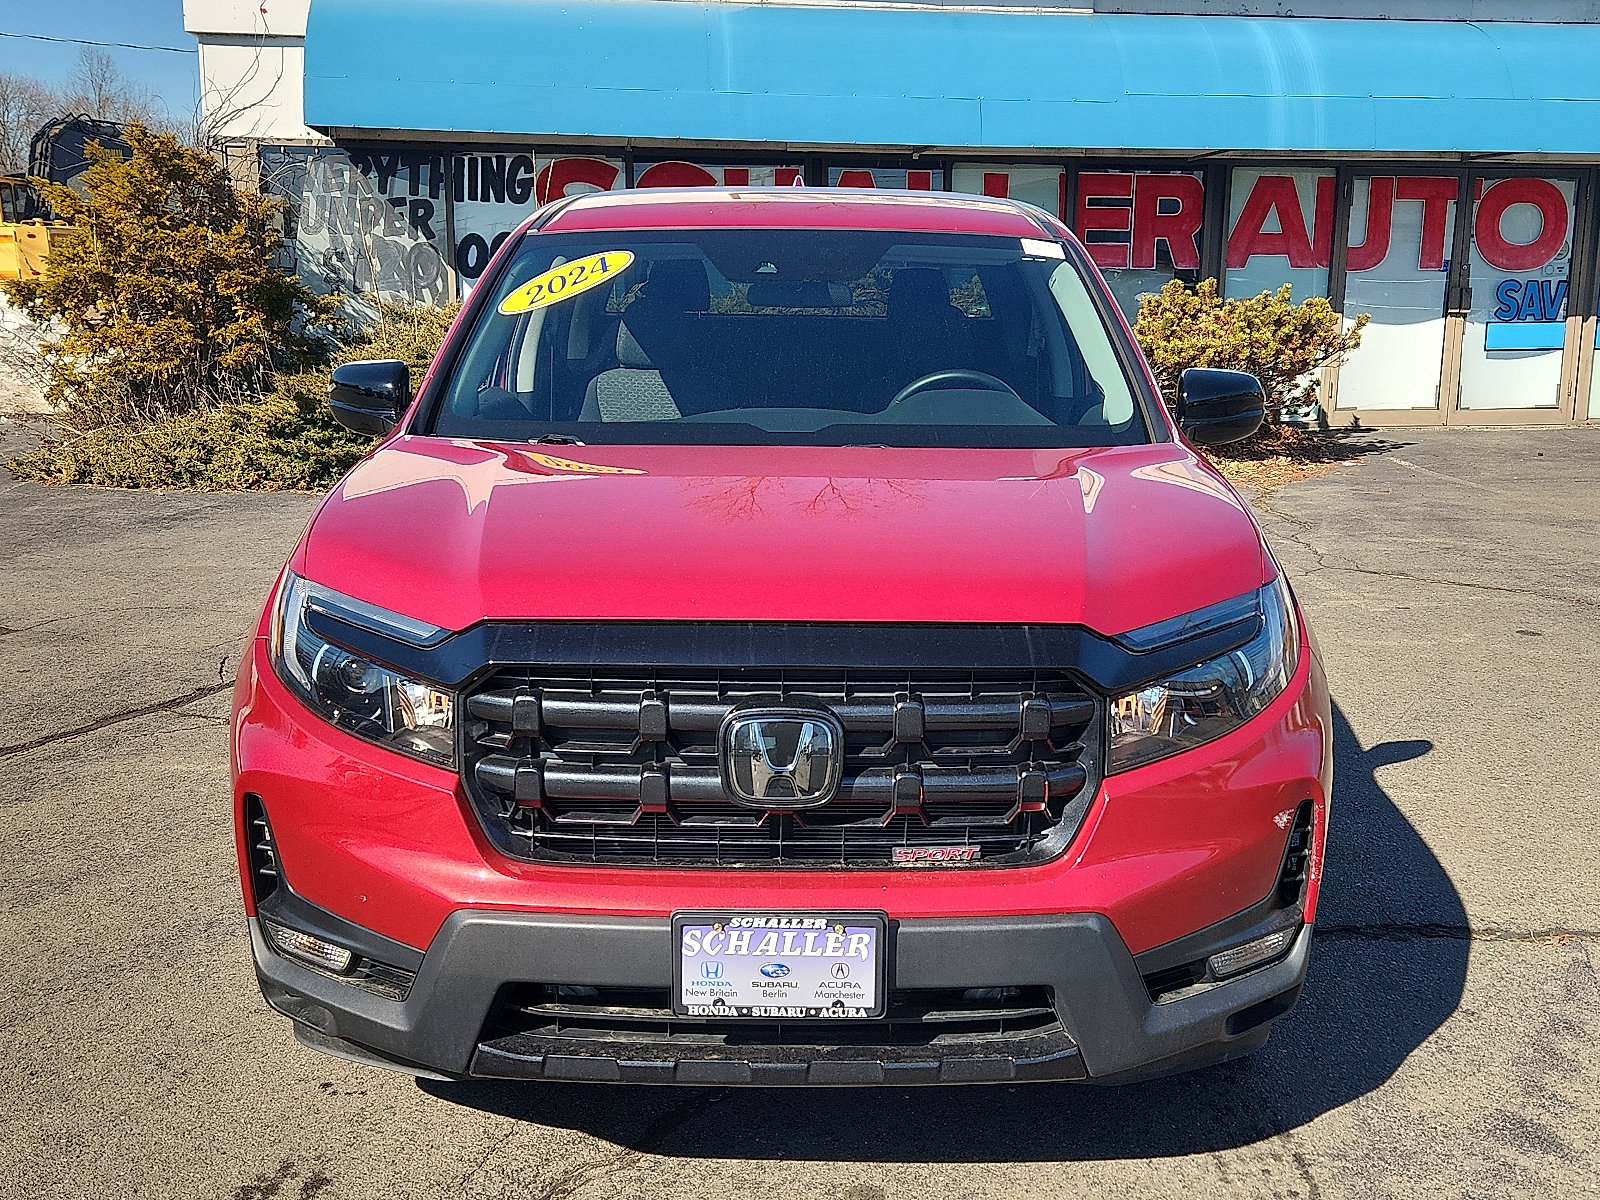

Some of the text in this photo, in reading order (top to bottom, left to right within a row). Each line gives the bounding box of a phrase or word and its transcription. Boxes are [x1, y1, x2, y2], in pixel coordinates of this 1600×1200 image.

[300, 195, 436, 241] UNDER
[1225, 174, 1570, 273] AUTO
[526, 256, 612, 306] 2024
[892, 847, 980, 861] SPORT
[729, 918, 827, 930] SCHALLER
[682, 929, 871, 962] SCHALLER
[818, 981, 862, 989] ACURA
[685, 988, 738, 998] New Britain
[762, 989, 788, 998] Berlin
[814, 990, 866, 1000] Manchester
[687, 1005, 868, 1018] HONDA SUBARU ACURA
